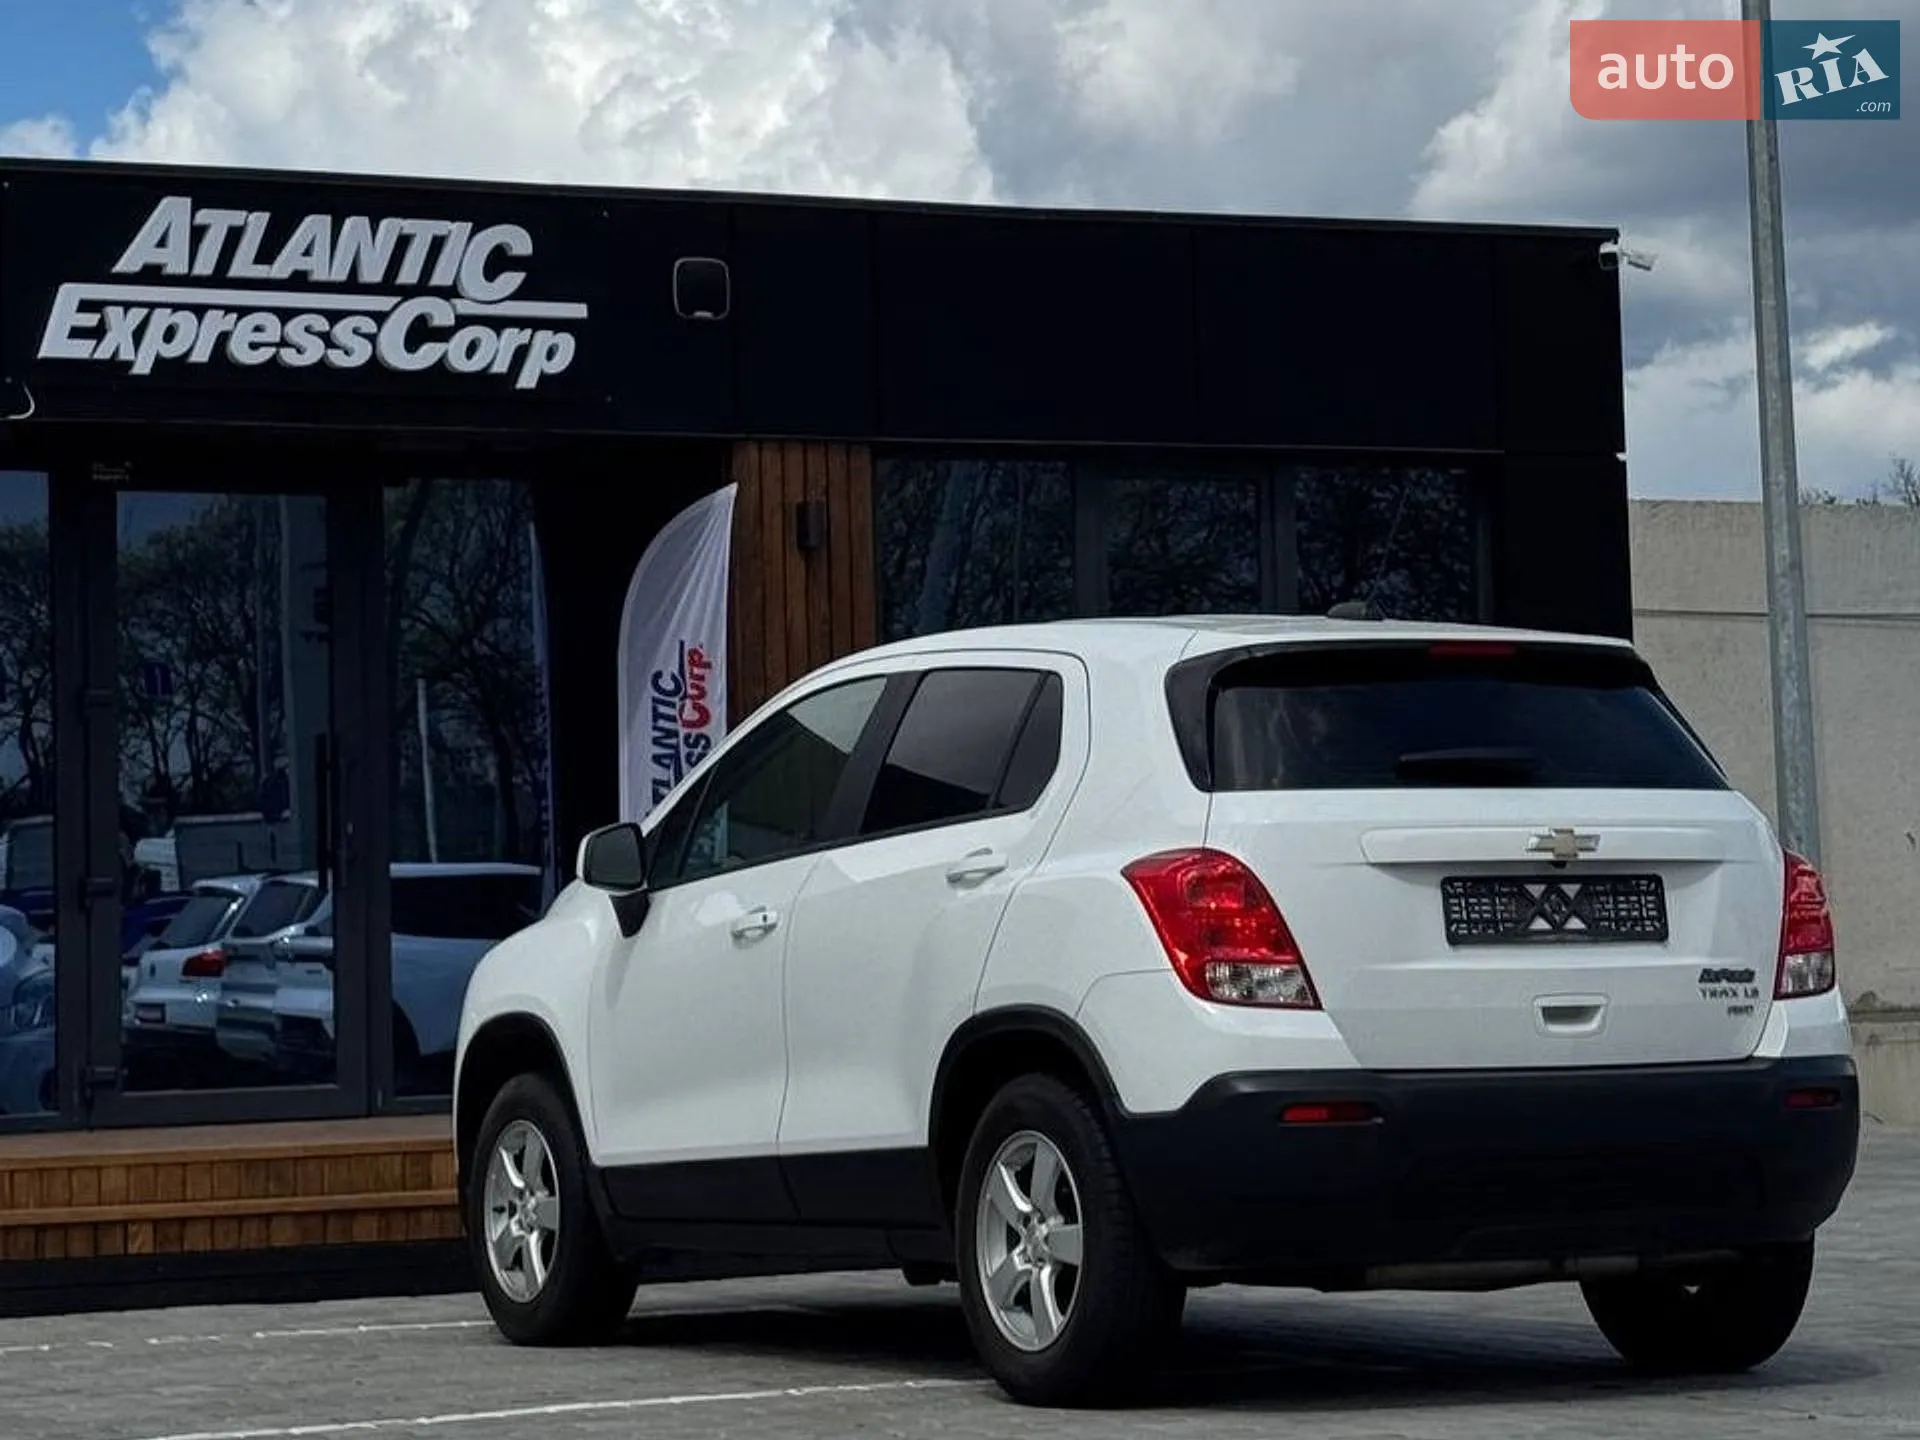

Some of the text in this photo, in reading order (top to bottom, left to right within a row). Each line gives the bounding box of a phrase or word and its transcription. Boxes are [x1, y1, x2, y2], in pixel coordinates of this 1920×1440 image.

[111, 196, 533, 302] ATLANTIC
[38, 283, 576, 390] ExpressCorp
[650, 670, 683, 806] TLANTIC
